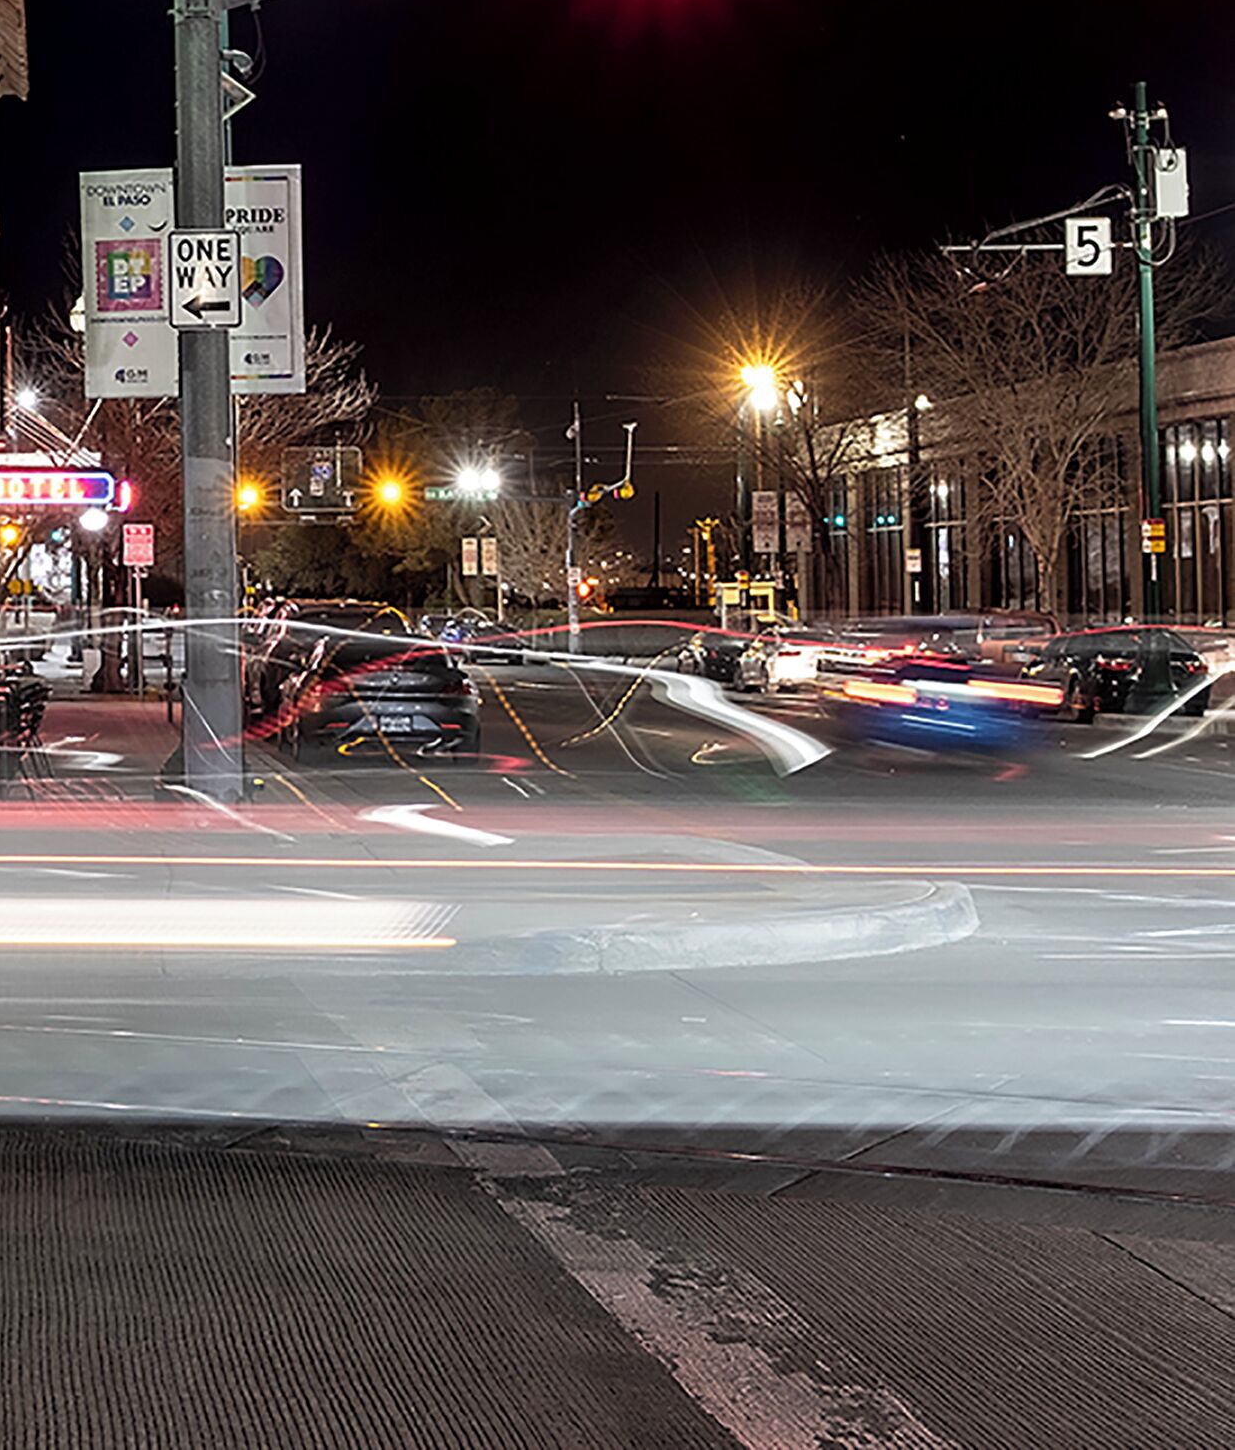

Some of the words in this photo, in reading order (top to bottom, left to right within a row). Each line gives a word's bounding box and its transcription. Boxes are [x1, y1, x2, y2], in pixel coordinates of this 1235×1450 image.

[87, 182, 166, 197] DOWNTOWN
[103, 196, 115, 206] EL
[118, 193, 151, 206] PASO
[225, 207, 285, 223] PRIDE
[177, 238, 231, 262] ONE
[1077, 225, 1100, 267] 5
[176, 265, 233, 288] WAY
